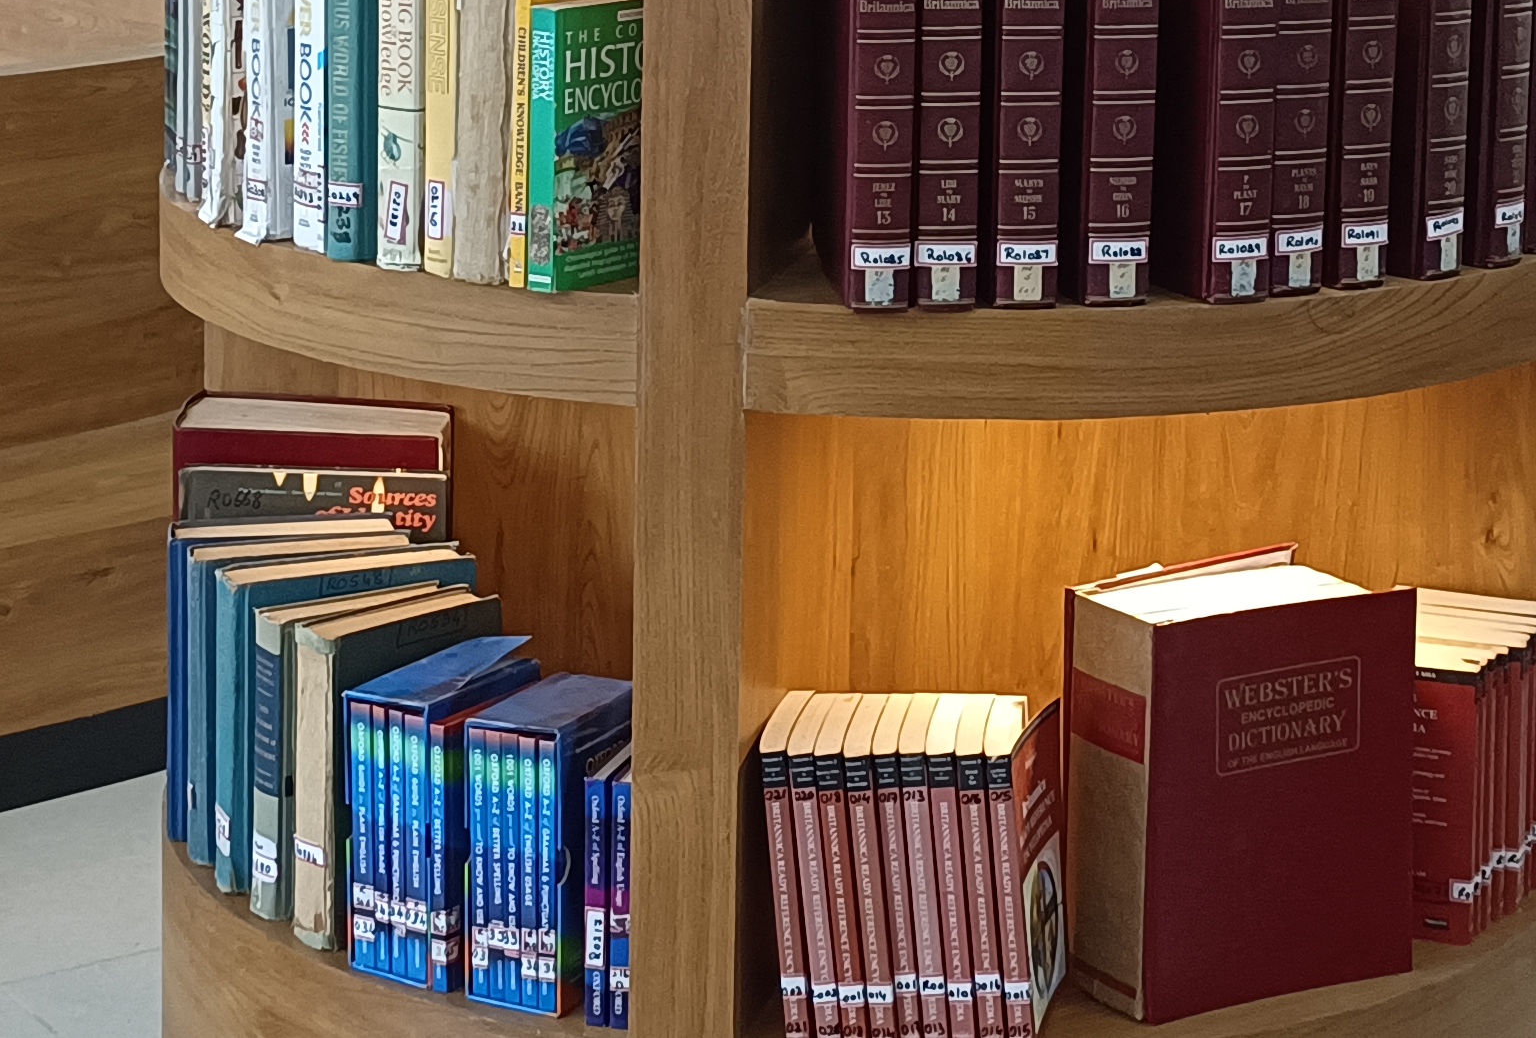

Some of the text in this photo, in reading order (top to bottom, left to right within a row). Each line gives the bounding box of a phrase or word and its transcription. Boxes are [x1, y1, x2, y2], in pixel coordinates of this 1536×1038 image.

[565, 28, 601, 45] THE
[250, 37, 262, 117] BOOK
[331, 35, 350, 96] WORLD
[398, 30, 413, 94] BOOK
[539, 31, 554, 102] HISTORY
[299, 43, 312, 122] BOOK
[331, 103, 349, 124] OF
[513, 27, 527, 213] CHILDREN'S KNOWLEDGE BANK
[1116, 204, 1130, 218] 16
[1239, 202, 1253, 216] 17
[1298, 195, 1310, 210] 18
[1363, 189, 1375, 203] 19
[877, 211, 892, 225] 13
[942, 208, 956, 222] 14
[1022, 206, 1036, 220] 15
[349, 485, 437, 508] Sources
[1224, 667, 1353, 709] WEBSTER'S
[1241, 696, 1336, 725] ENCYCLOPEDIC
[1228, 709, 1347, 752] DICTIONARY
[772, 802, 785, 859] BRITANNICA
[855, 805, 868, 863] BRITANNICA
[884, 802, 897, 859] BRITANNICA
[939, 802, 952, 859] BRITANNICA
[969, 804, 981, 862] BRITANNICA
[777, 860, 787, 892] READY
[827, 805, 848, 950] BRITANNICA READY REFERENCE
[860, 864, 872, 896] READY
[889, 860, 900, 893] READY
[944, 860, 955, 892] READY
[974, 863, 985, 896] READY
[996, 803, 1018, 949] BRITANNICA READY REFERENCE
